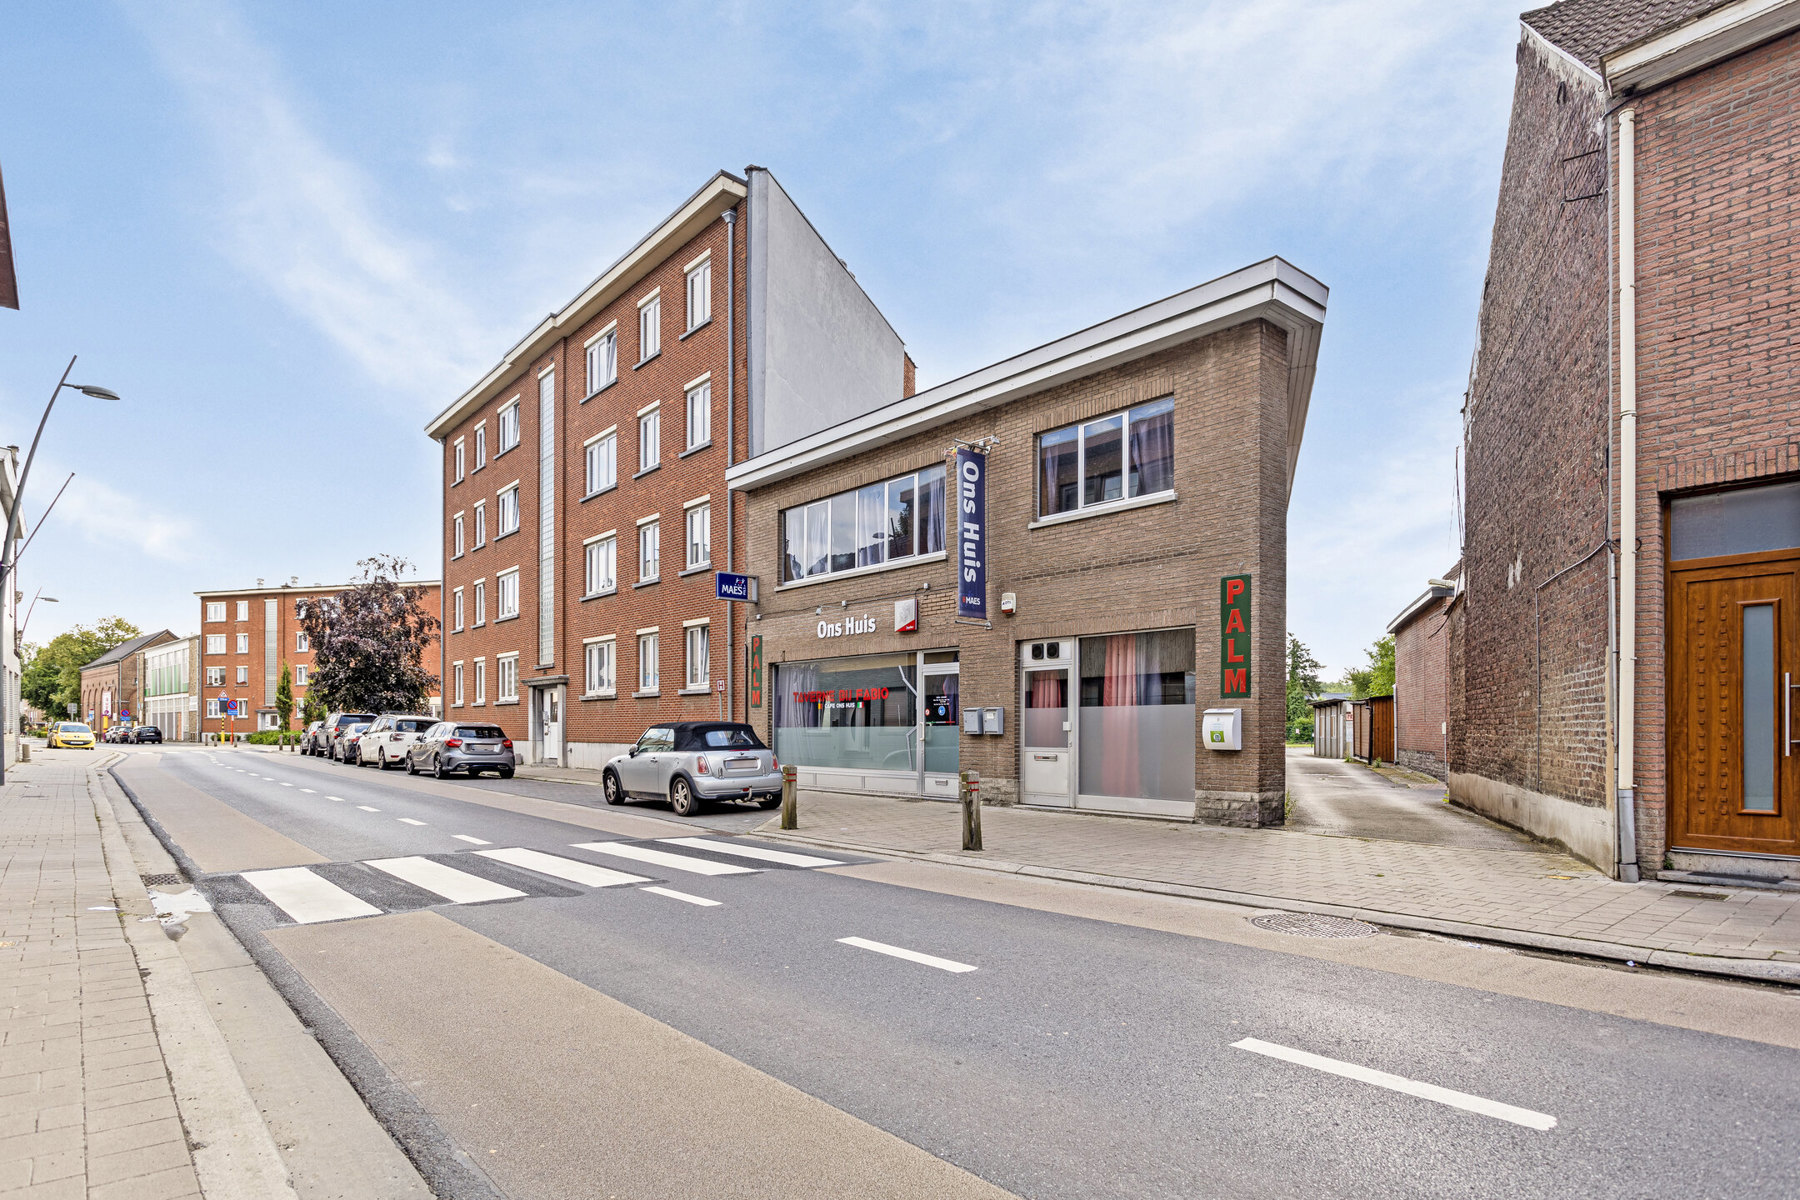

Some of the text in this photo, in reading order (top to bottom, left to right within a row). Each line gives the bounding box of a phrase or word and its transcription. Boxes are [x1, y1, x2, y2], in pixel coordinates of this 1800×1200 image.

[963, 461, 981, 583] Ons Huis
[721, 584, 743, 595] MAES
[965, 596, 981, 606] MAES
[817, 613, 876, 638] Ons Huis
[1224, 579, 1247, 694] PALM
[752, 637, 761, 705] PALM
[793, 690, 835, 703] TAVERNE
[856, 687, 889, 701] FABIO
